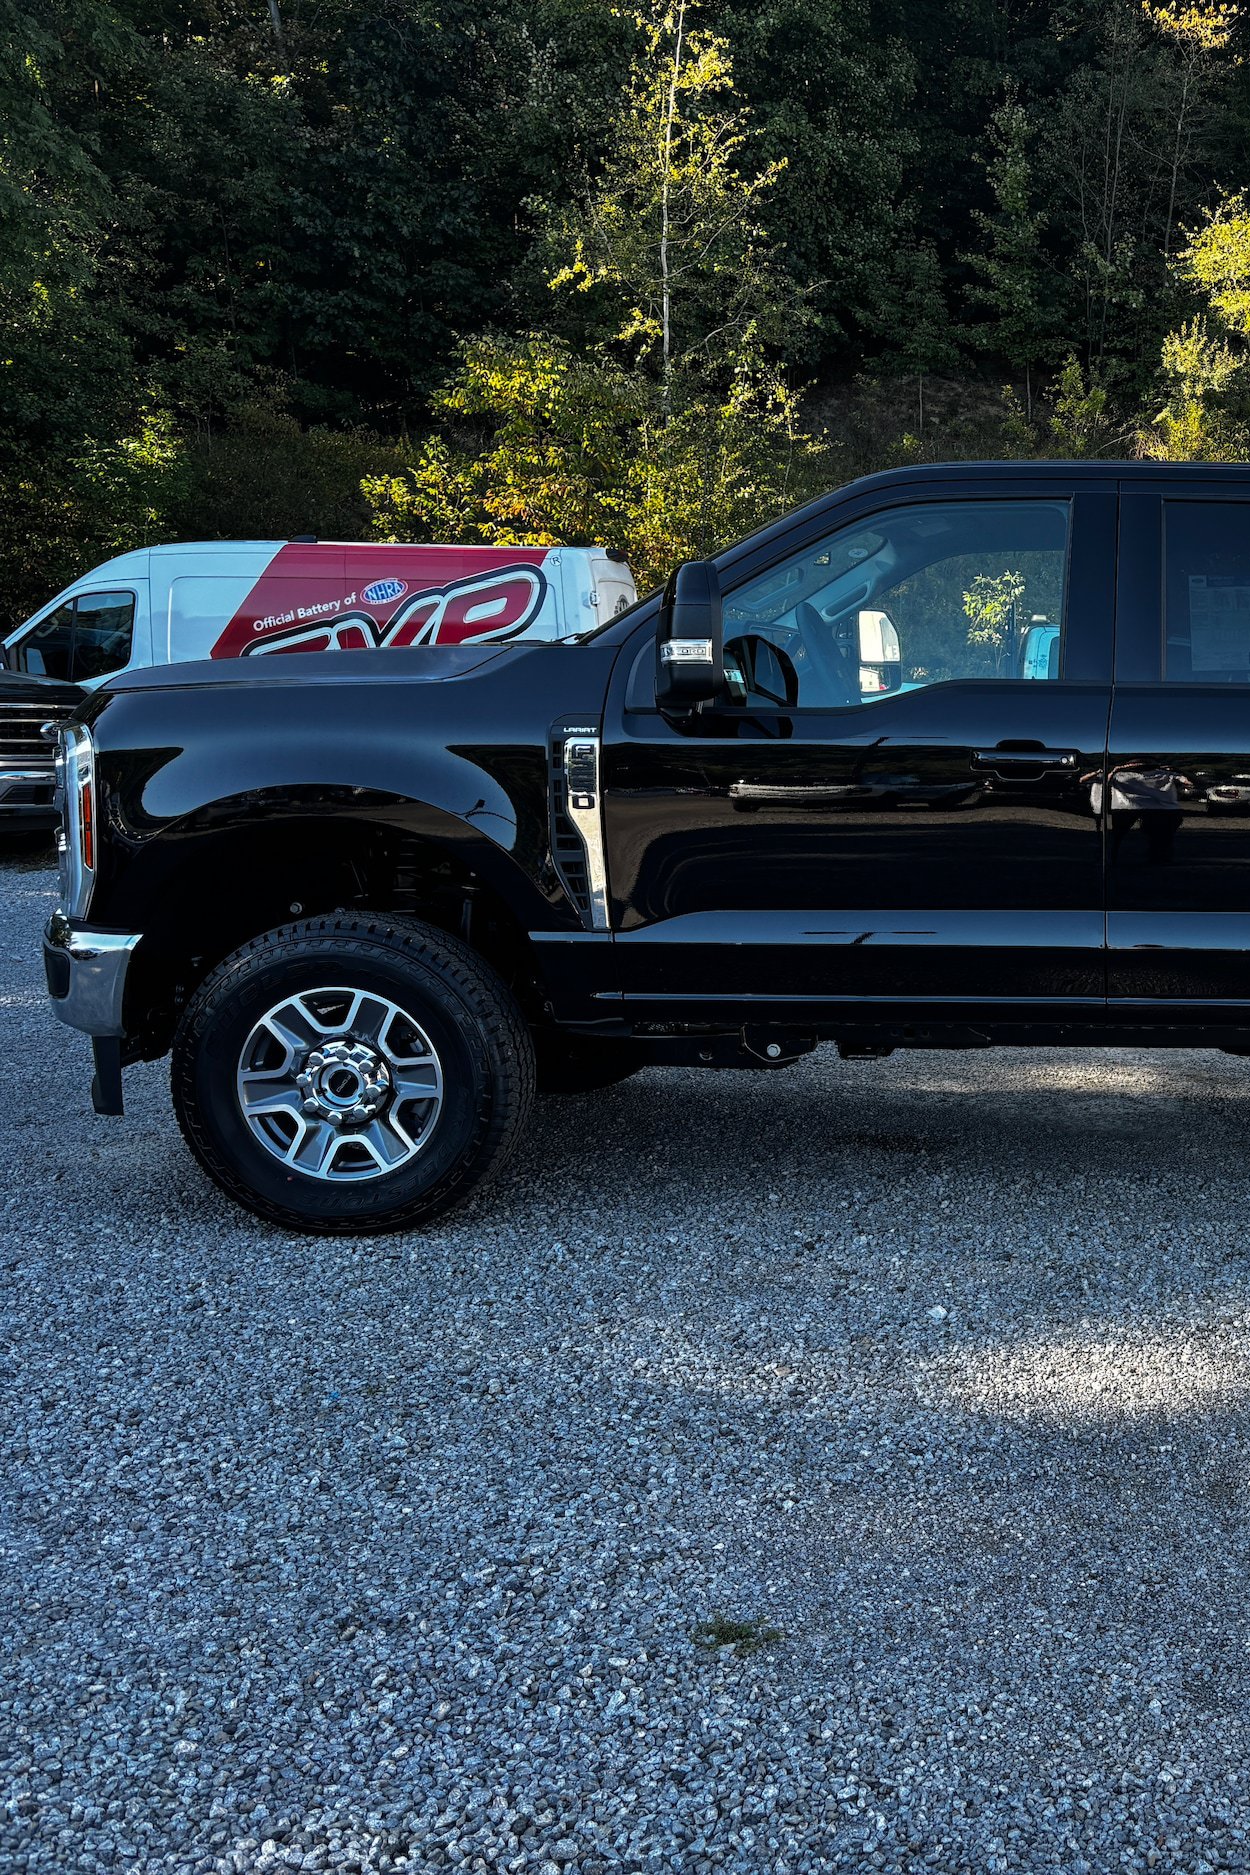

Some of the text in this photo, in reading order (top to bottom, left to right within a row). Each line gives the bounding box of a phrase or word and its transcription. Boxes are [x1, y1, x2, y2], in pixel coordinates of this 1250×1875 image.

[367, 582, 402, 601] NHRA
[253, 591, 357, 632] Official Battery of
